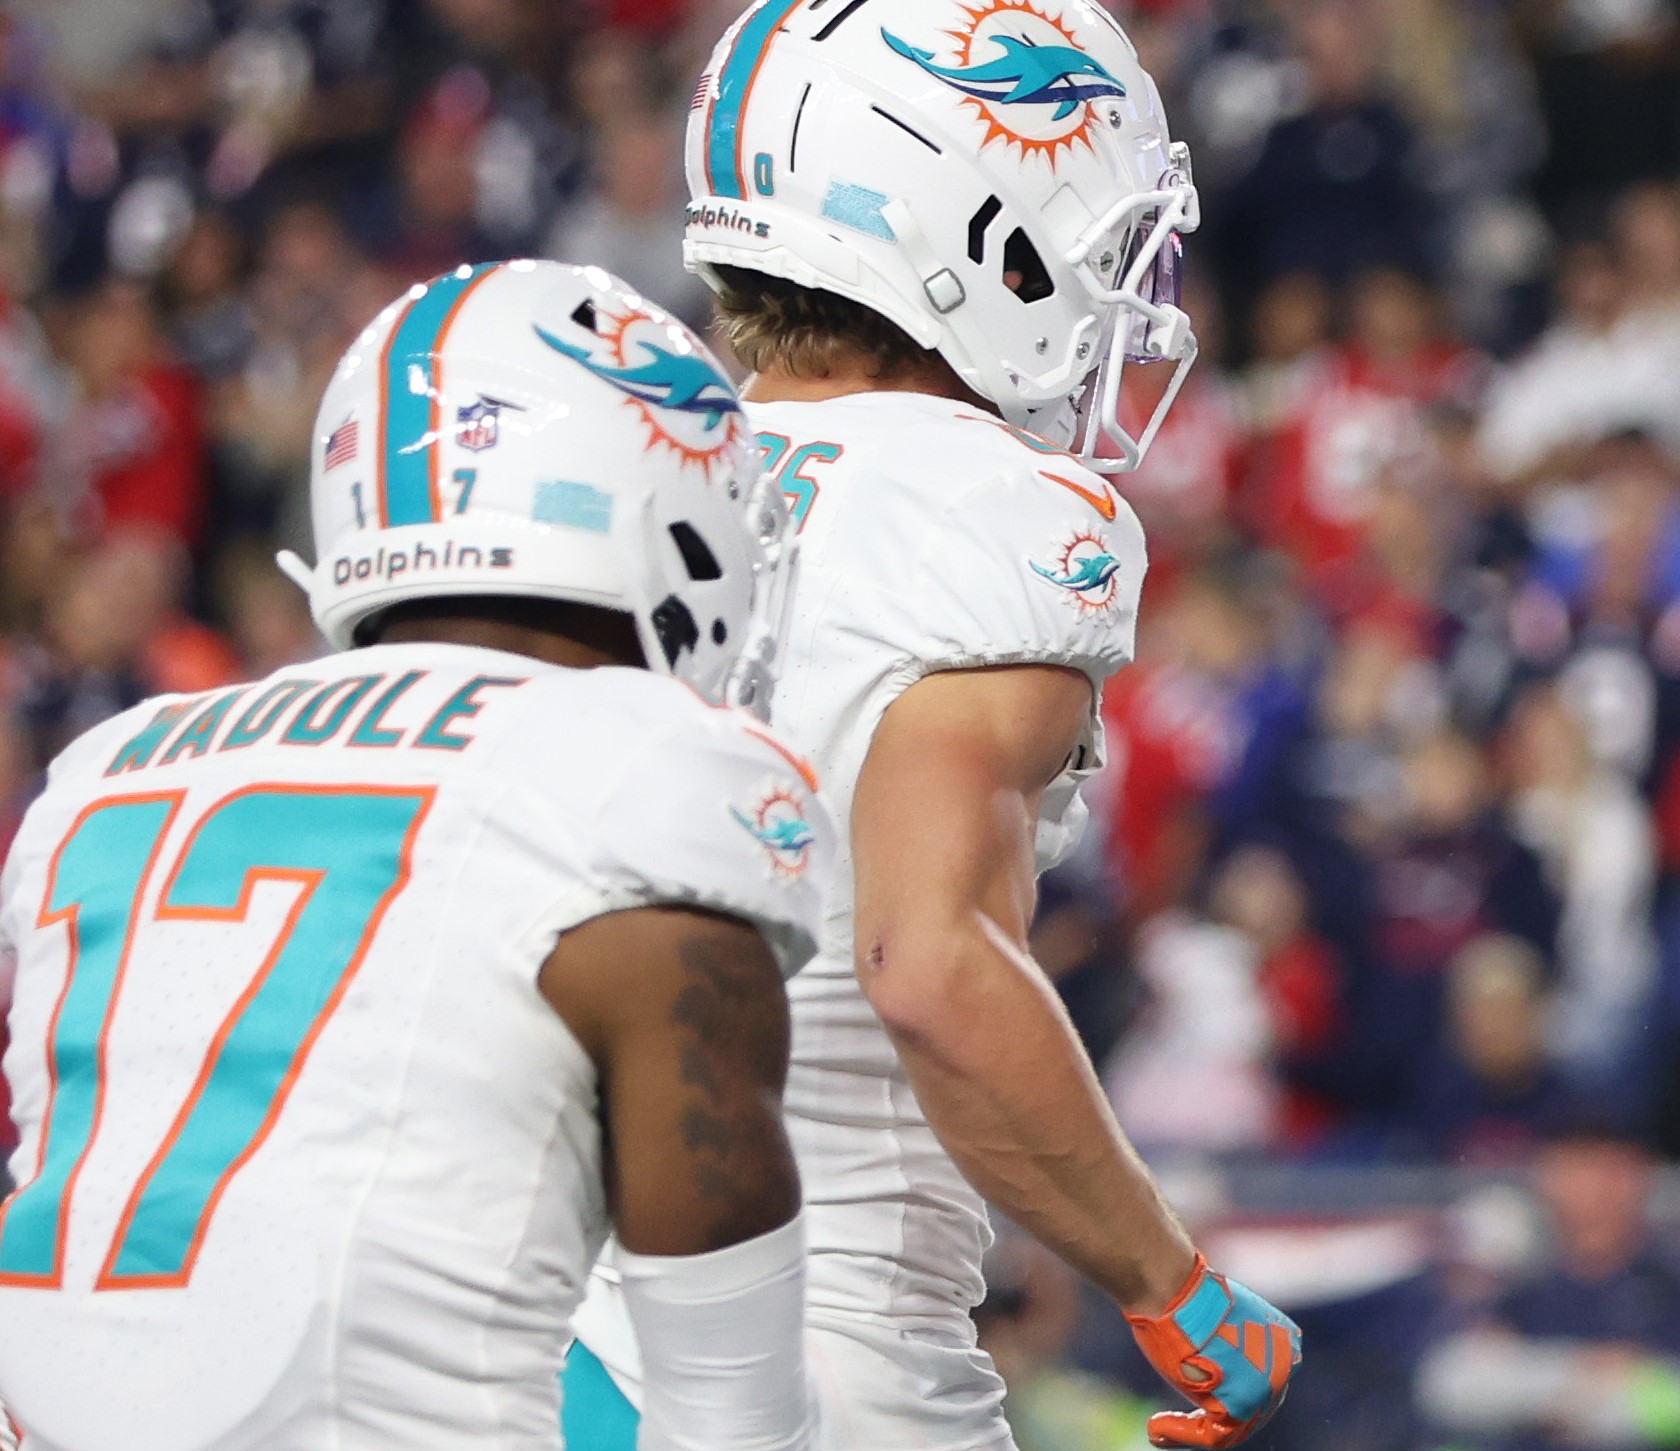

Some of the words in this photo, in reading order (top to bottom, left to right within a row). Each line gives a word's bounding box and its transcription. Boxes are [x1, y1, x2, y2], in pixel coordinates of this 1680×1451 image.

[754, 152, 774, 197] 0
[333, 539, 514, 586] Dolphins
[0, 781, 438, 1292] 17
